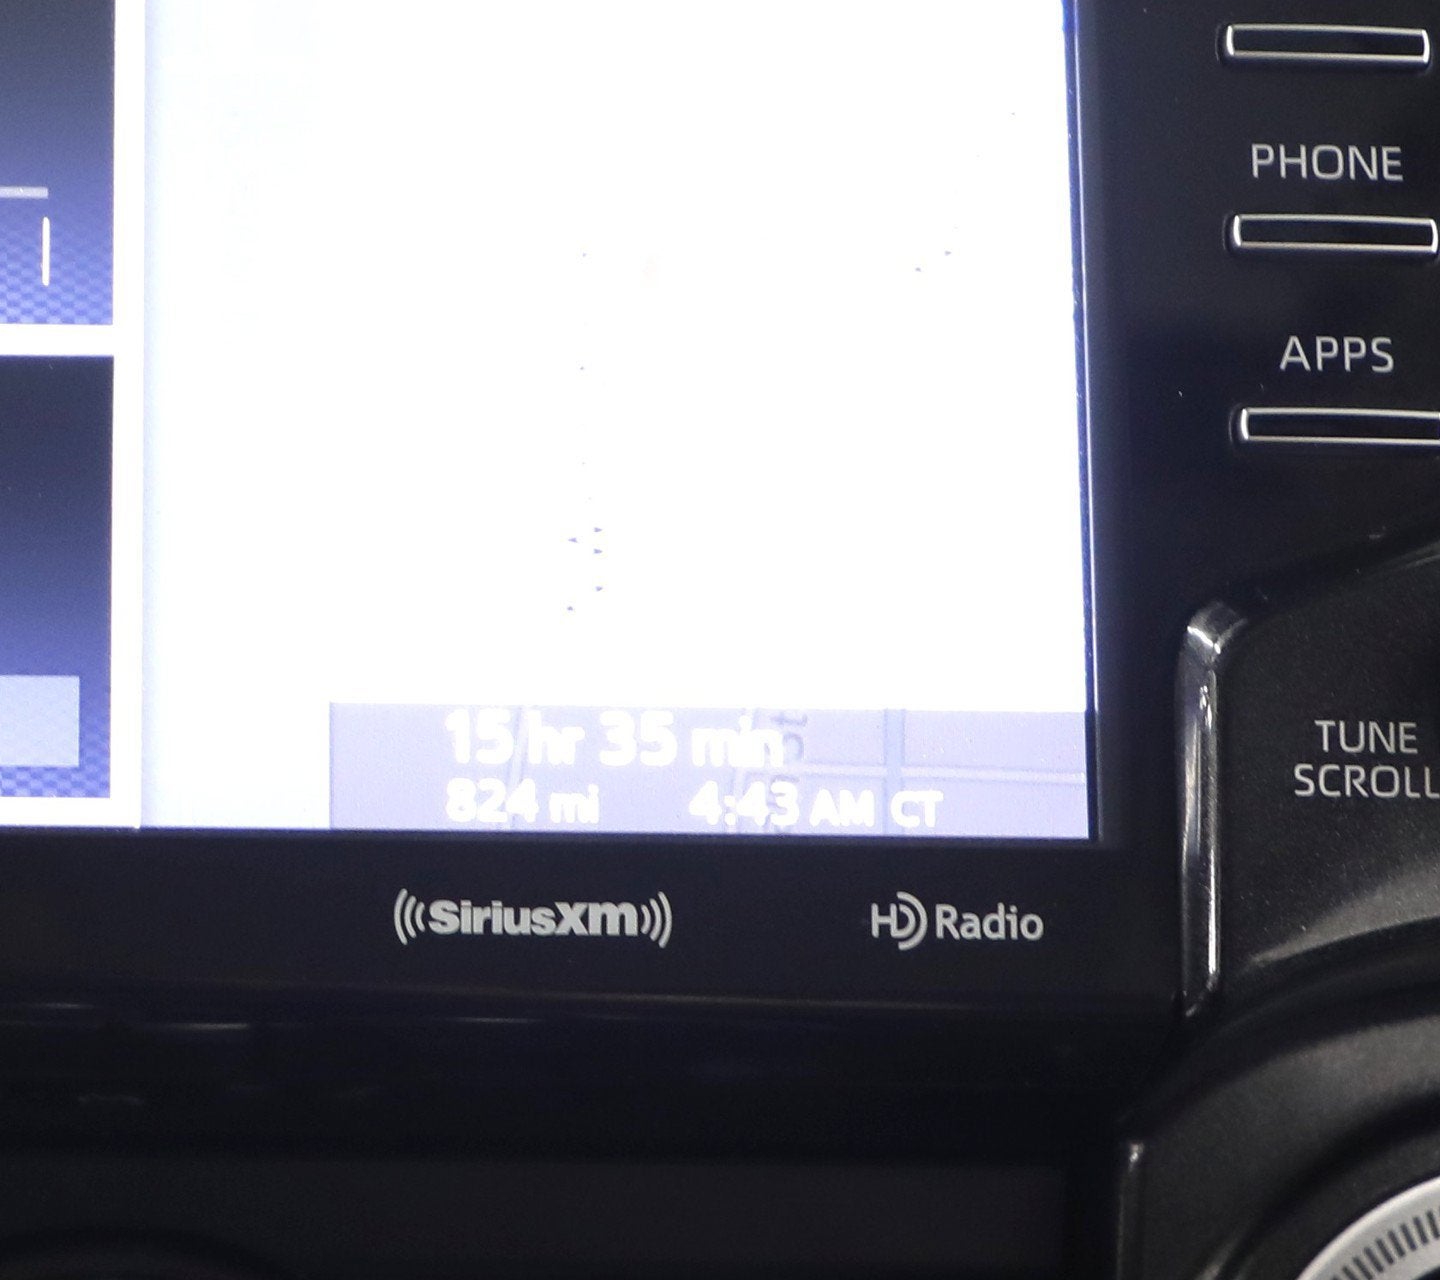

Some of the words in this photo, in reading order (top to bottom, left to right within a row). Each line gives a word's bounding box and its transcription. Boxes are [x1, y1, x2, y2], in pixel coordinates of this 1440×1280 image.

[1250, 143, 1405, 182] PHONE
[1278, 335, 1396, 373] APPS
[444, 709, 514, 766] 15
[526, 708, 586, 766] hr
[598, 710, 676, 767] 35
[690, 713, 786, 768] min
[1313, 719, 1419, 755] TUNE
[444, 778, 540, 824] 824
[548, 782, 600, 825] mi
[687, 781, 800, 828] 4:43
[808, 788, 876, 828] AM
[888, 788, 945, 828] CT
[935, 902, 1045, 941] Radio
